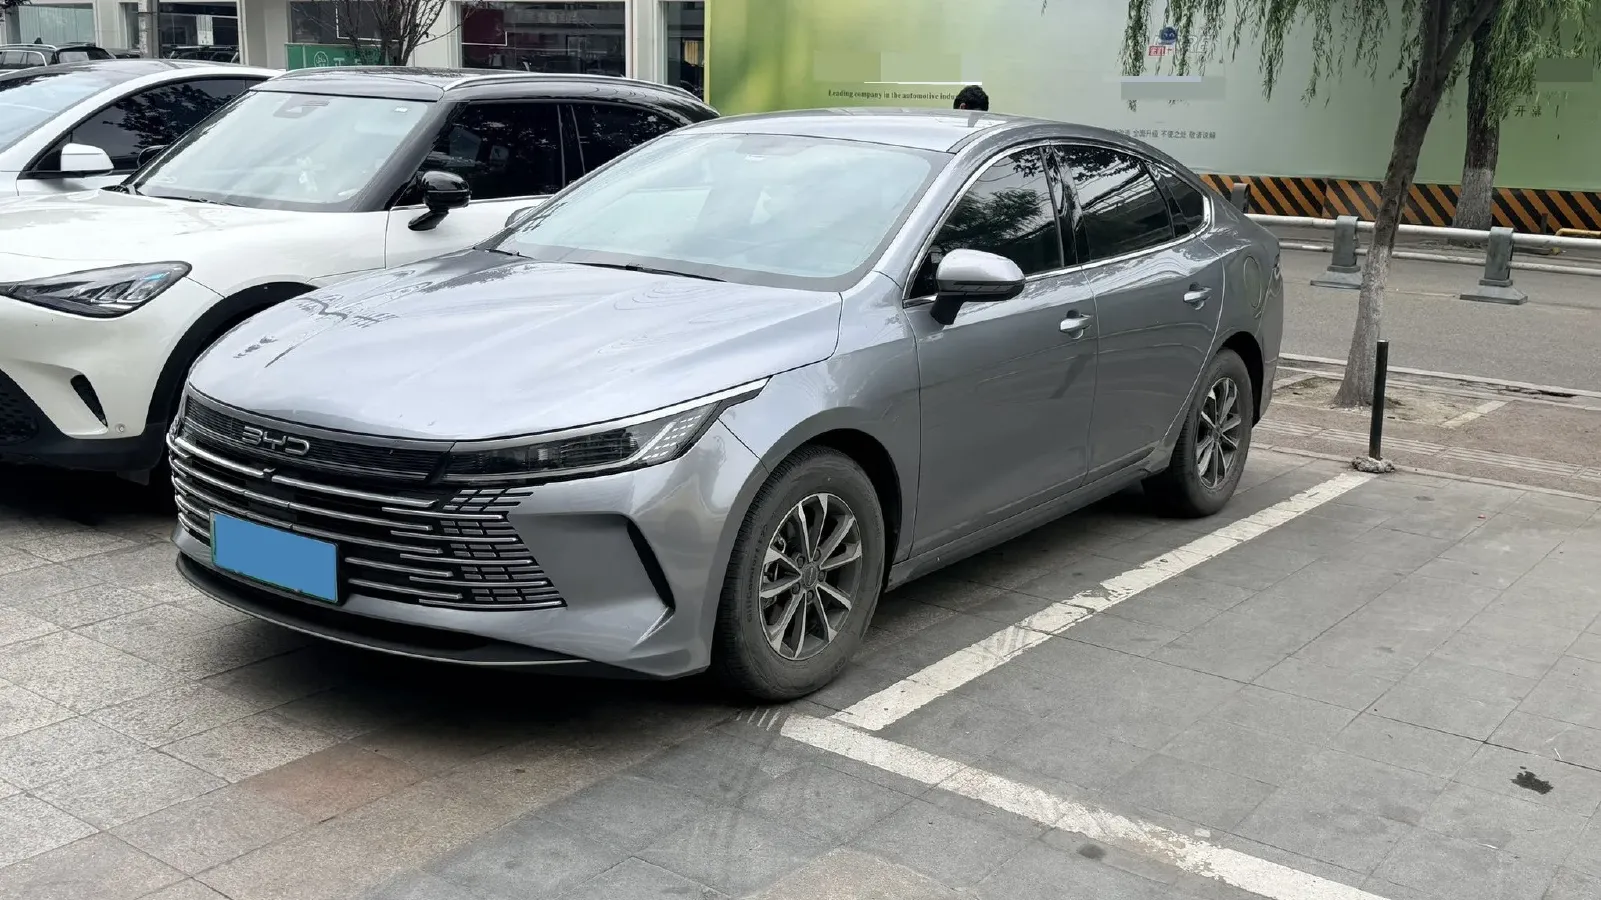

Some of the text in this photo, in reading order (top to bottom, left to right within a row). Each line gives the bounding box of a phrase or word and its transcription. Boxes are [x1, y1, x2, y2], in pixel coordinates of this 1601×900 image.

[828, 89, 854, 98] Leading
[854, 91, 882, 99] company
[891, 91, 902, 99] the
[902, 92, 939, 100] automotive
[940, 92, 957, 100] indu
[1160, 130, 1187, 139] 不便之处
[242, 425, 310, 456] BYD
